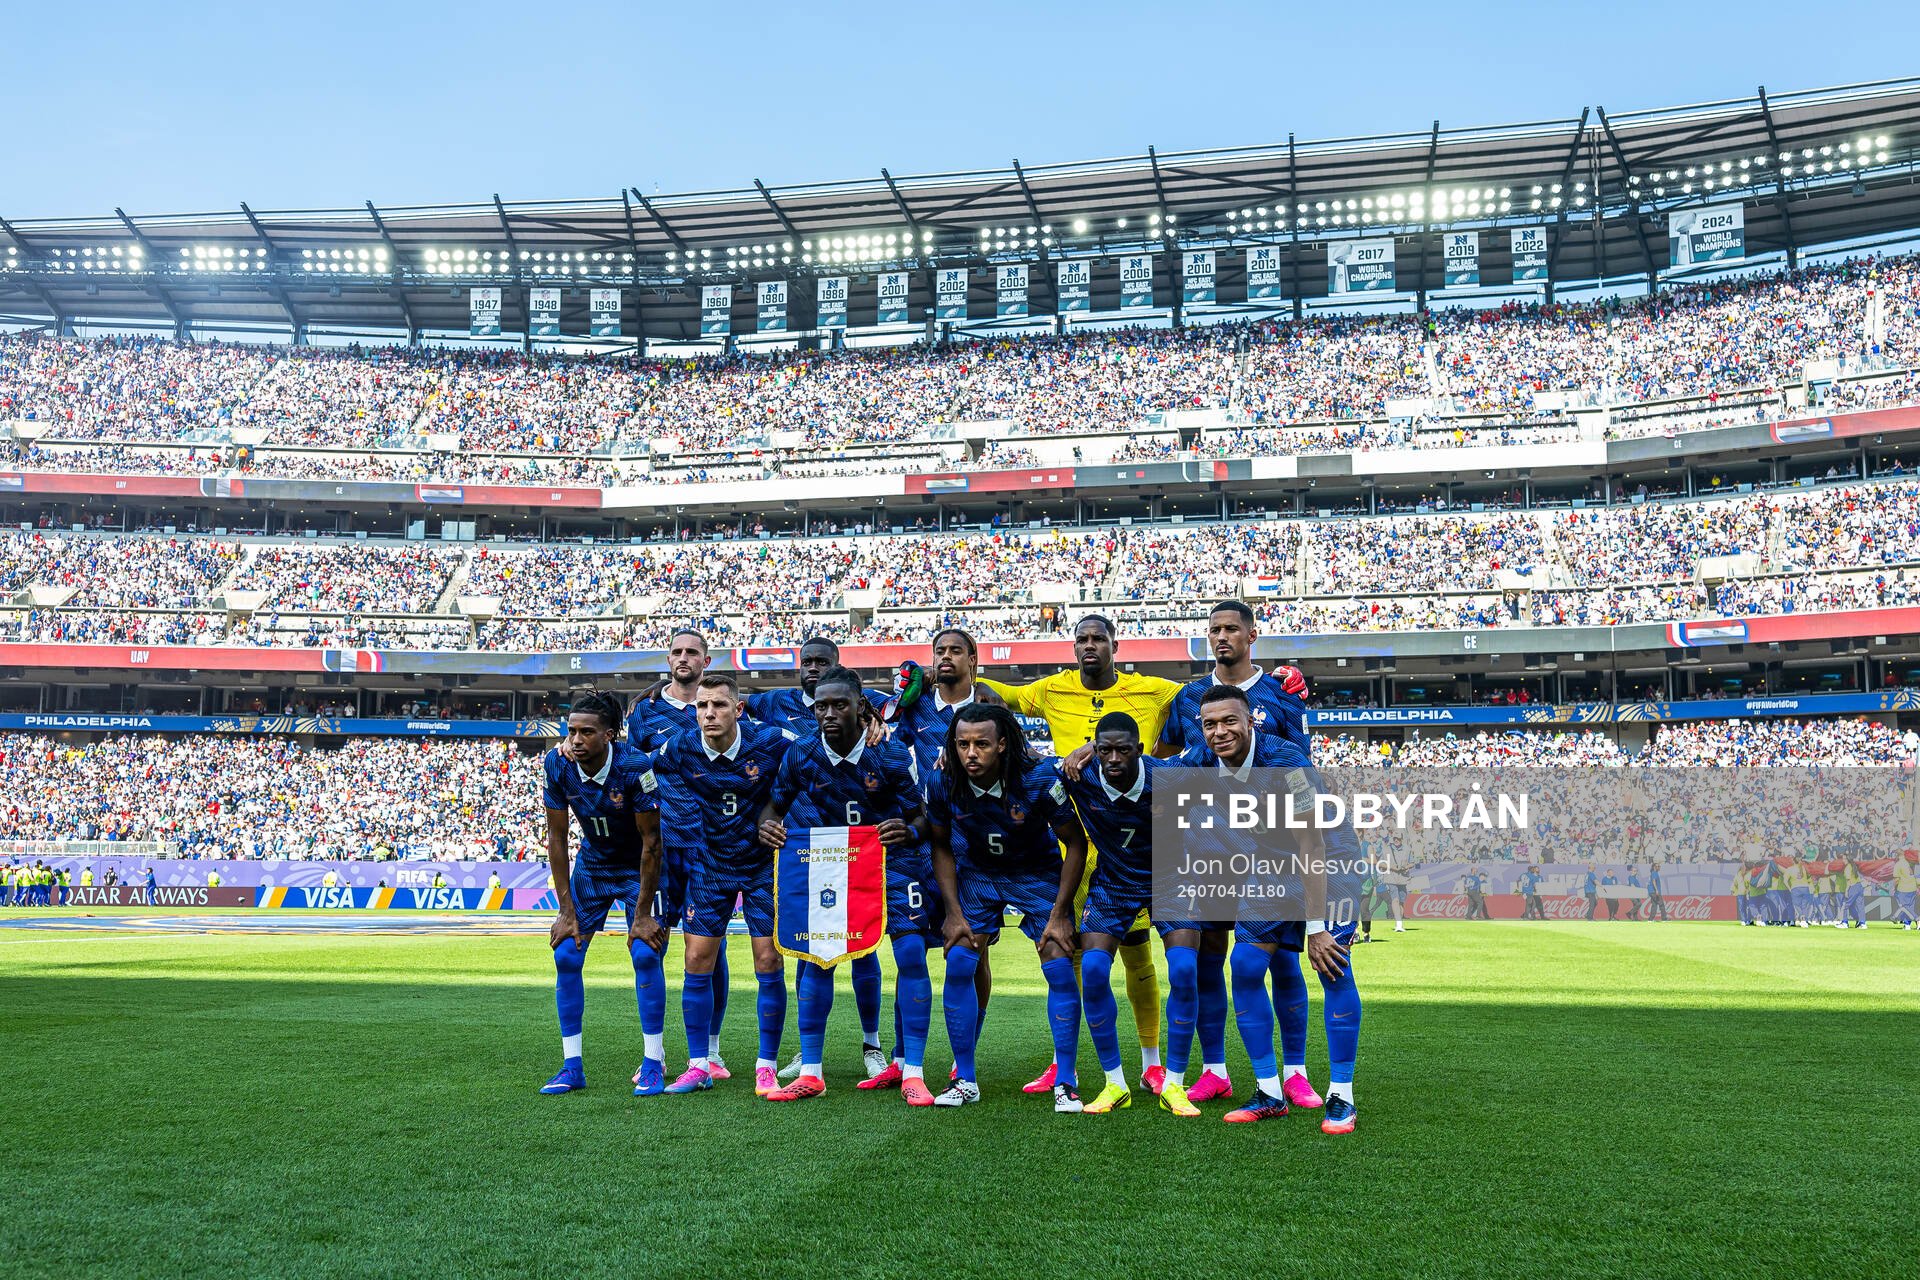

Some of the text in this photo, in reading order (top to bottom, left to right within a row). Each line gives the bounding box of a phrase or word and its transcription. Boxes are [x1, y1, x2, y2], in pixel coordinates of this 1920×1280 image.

[1702, 215, 1733, 229] 2024
[1703, 232, 1731, 243] WORLD
[1448, 245, 1475, 256] 2019
[1515, 240, 1544, 251] 2022
[1695, 239, 1741, 252] CHAMPIONS
[1358, 249, 1384, 260] 2017
[1187, 264, 1211, 274] 2010
[1251, 259, 1276, 270] 2013
[1358, 265, 1384, 273] WORLD
[1060, 273, 1087, 284] 2004
[1123, 268, 1150, 279] 2006
[1350, 271, 1393, 282] CHAMPIONS
[939, 281, 965, 291] 2002
[1000, 277, 1025, 288] 2003
[822, 289, 844, 299] 1988
[881, 285, 905, 295] 2001
[706, 297, 728, 307] 1960
[761, 293, 784, 304] 1980
[474, 300, 498, 309] 1947
[534, 300, 557, 309] 1948
[595, 301, 617, 310] 1949
[1464, 635, 1477, 649] CE
[570, 657, 582, 669] CE
[1746, 700, 1799, 710] #FIFAWorldCup
[1317, 709, 1454, 722] PHILADELPHIA
[24, 716, 152, 727] PHILADELPHIA
[722, 793, 738, 816] 3
[845, 801, 861, 825] 6
[590, 816, 610, 837] 11
[1120, 828, 1136, 848] 7
[988, 833, 1004, 855] 5
[397, 870, 428, 882] FIFA
[128, 887, 209, 905] AIRWAYS
[301, 888, 355, 908] VISA
[409, 888, 465, 909] VISA
[907, 882, 923, 909] 6
[1639, 895, 1716, 919] Ca-Cola
[1327, 897, 1354, 931] 10
[794, 931, 863, 941] 1/8 DE FINALE
